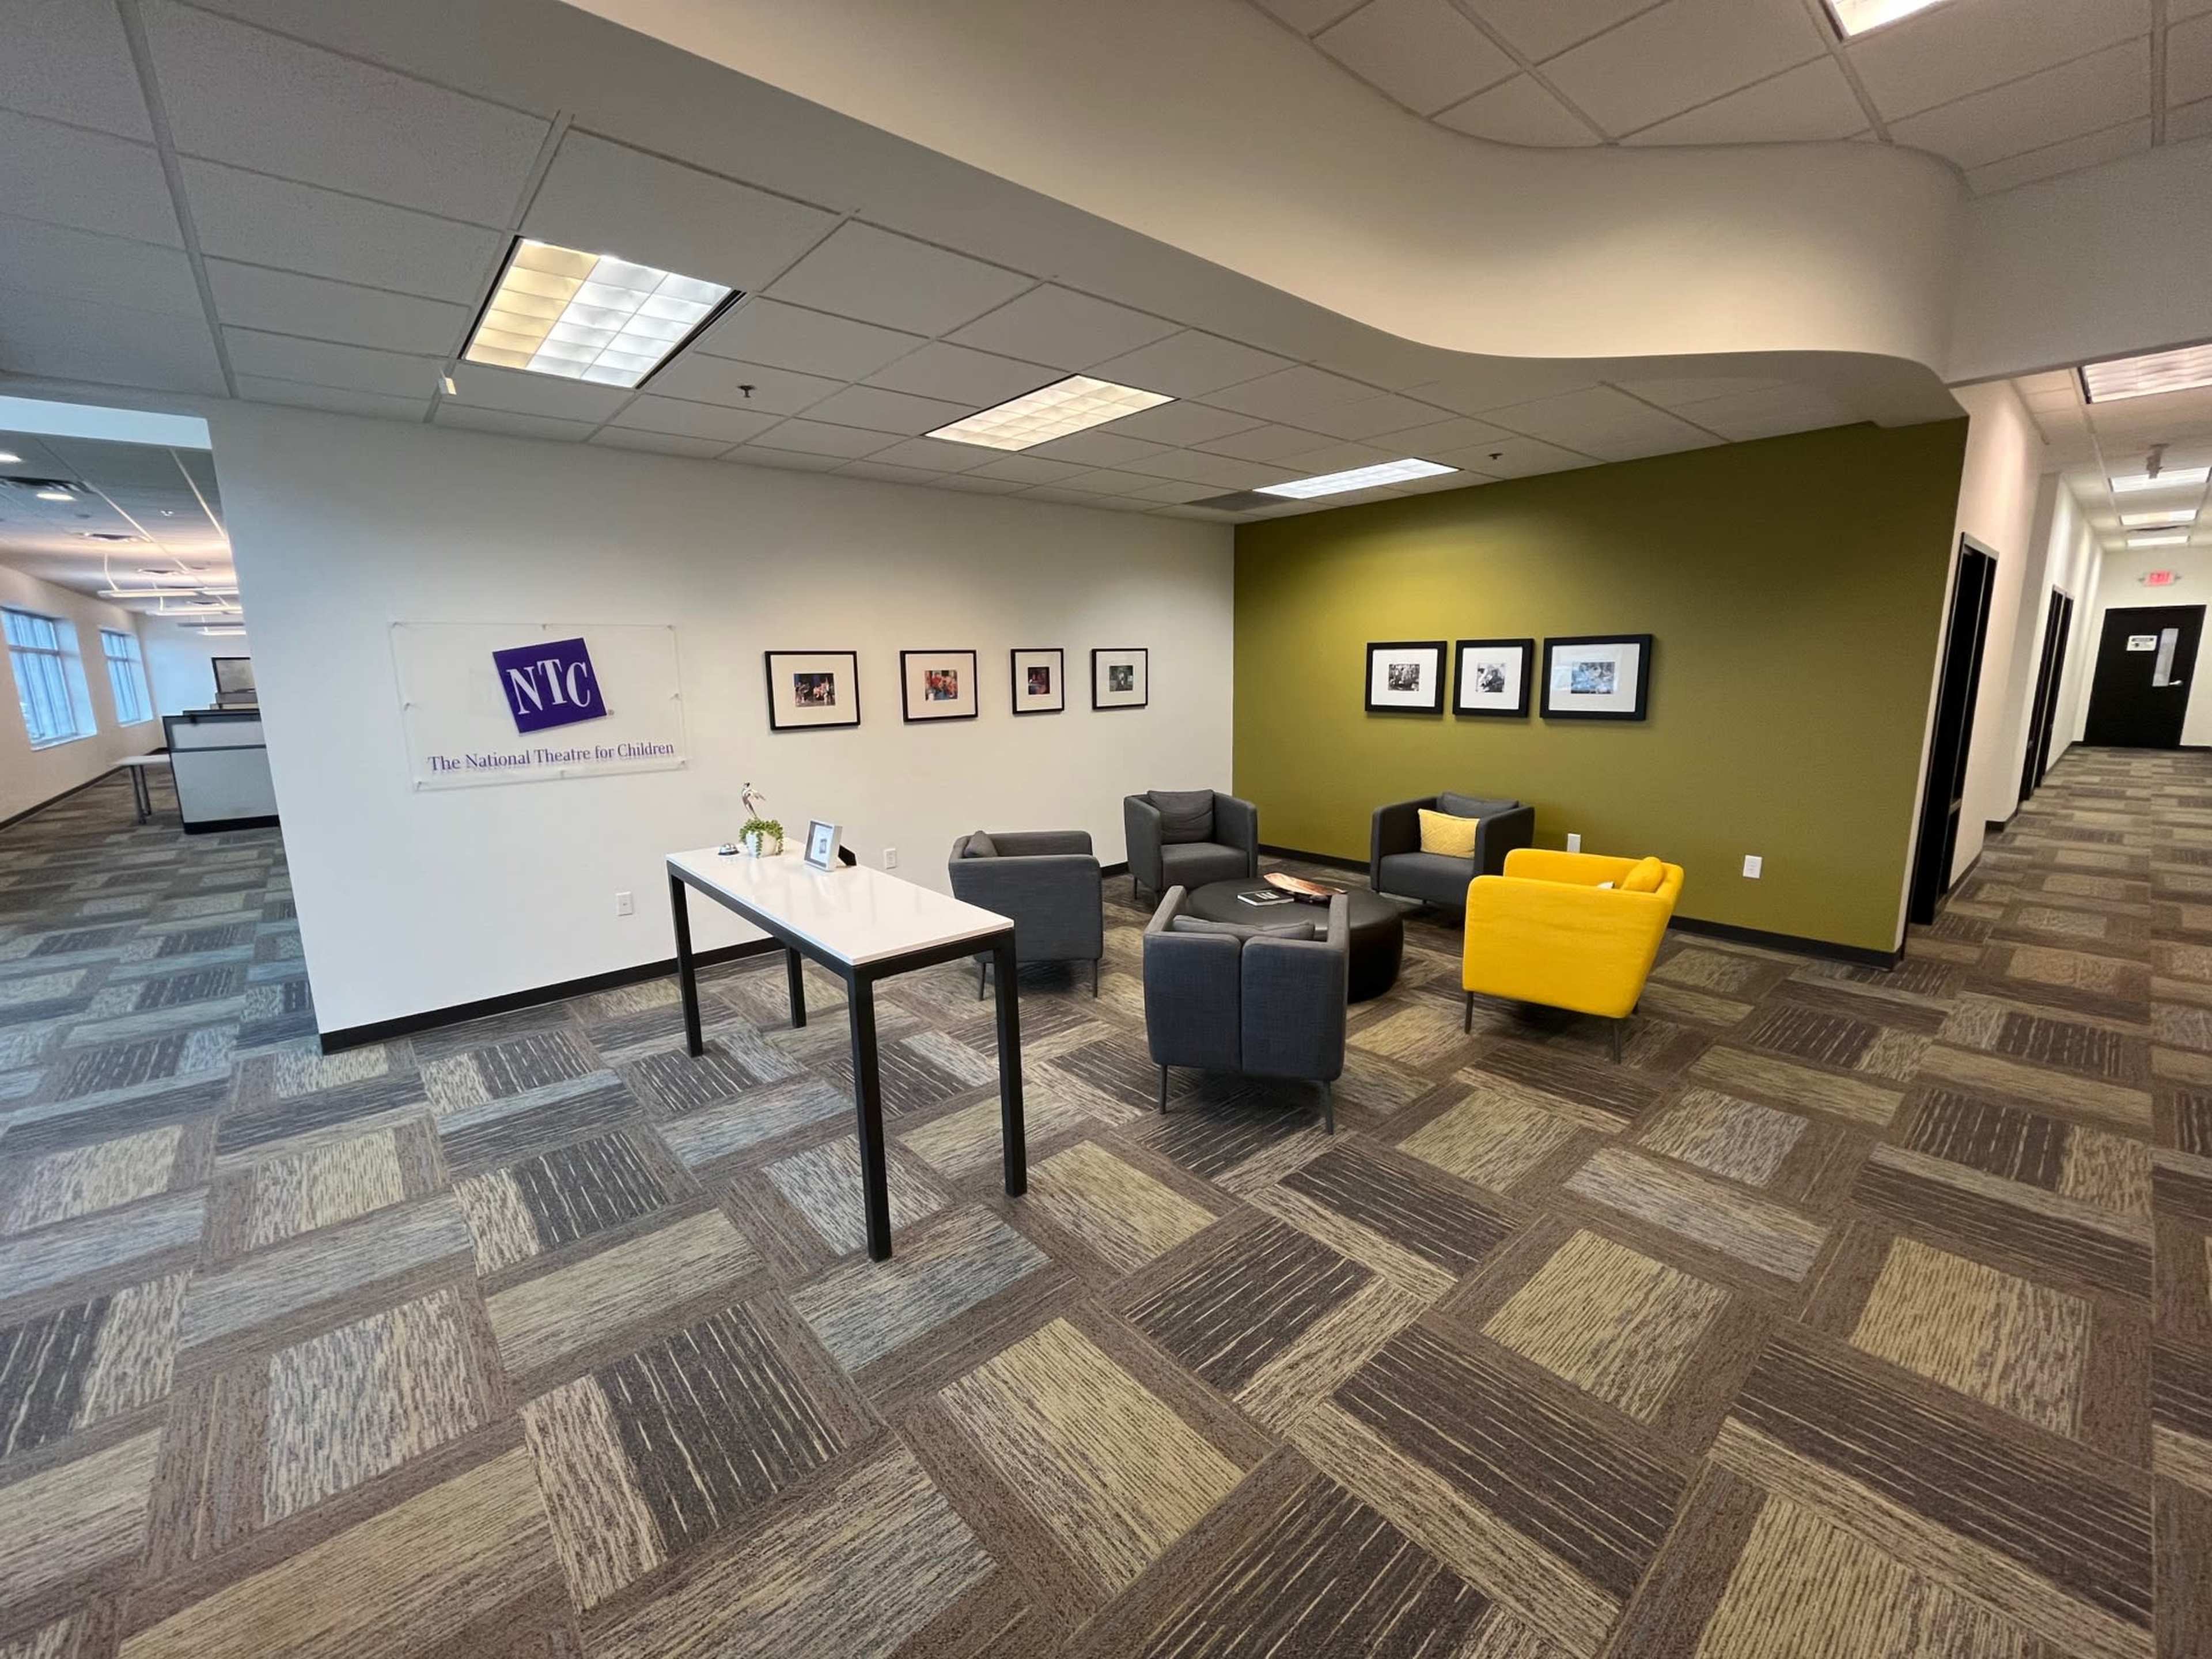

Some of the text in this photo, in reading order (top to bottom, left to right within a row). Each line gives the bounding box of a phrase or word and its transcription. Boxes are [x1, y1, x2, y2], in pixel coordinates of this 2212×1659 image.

[505, 658, 592, 714] NTC
[428, 742, 674, 771] The National Theatre for Children
